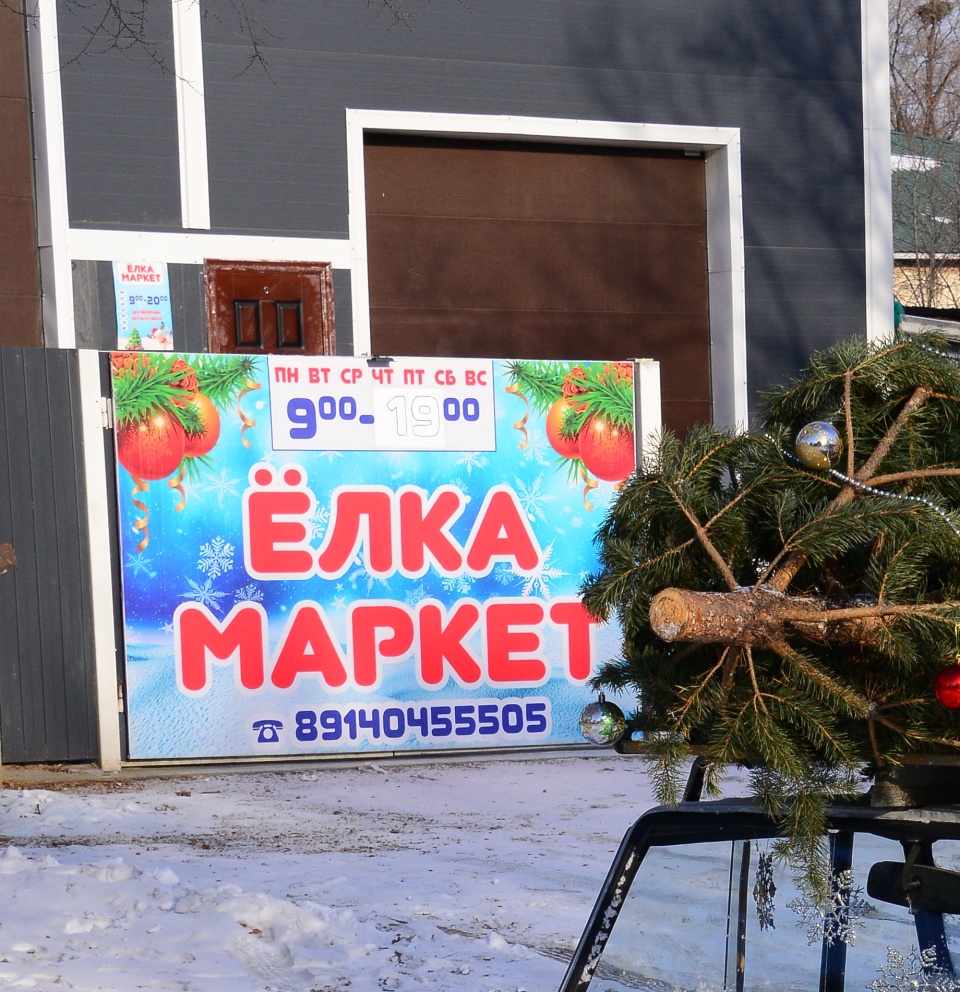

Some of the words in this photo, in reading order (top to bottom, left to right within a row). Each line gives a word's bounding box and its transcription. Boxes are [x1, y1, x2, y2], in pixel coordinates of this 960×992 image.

[121, 273, 161, 282] МАРКЕТ
[127, 263, 154, 273] ЁЛКА
[275, 367, 299, 383] ПН
[309, 368, 331, 384] ВТ
[341, 369, 363, 385] СР
[372, 369, 394, 385] ЧТ
[404, 370, 425, 385] ПТ
[435, 370, 457, 386] СБ
[465, 370, 487, 386] ВС
[247, 469, 539, 574] ЁЛКА
[180, 602, 604, 691] МАРКЕТ
[295, 702, 547, 742] 89140455505
